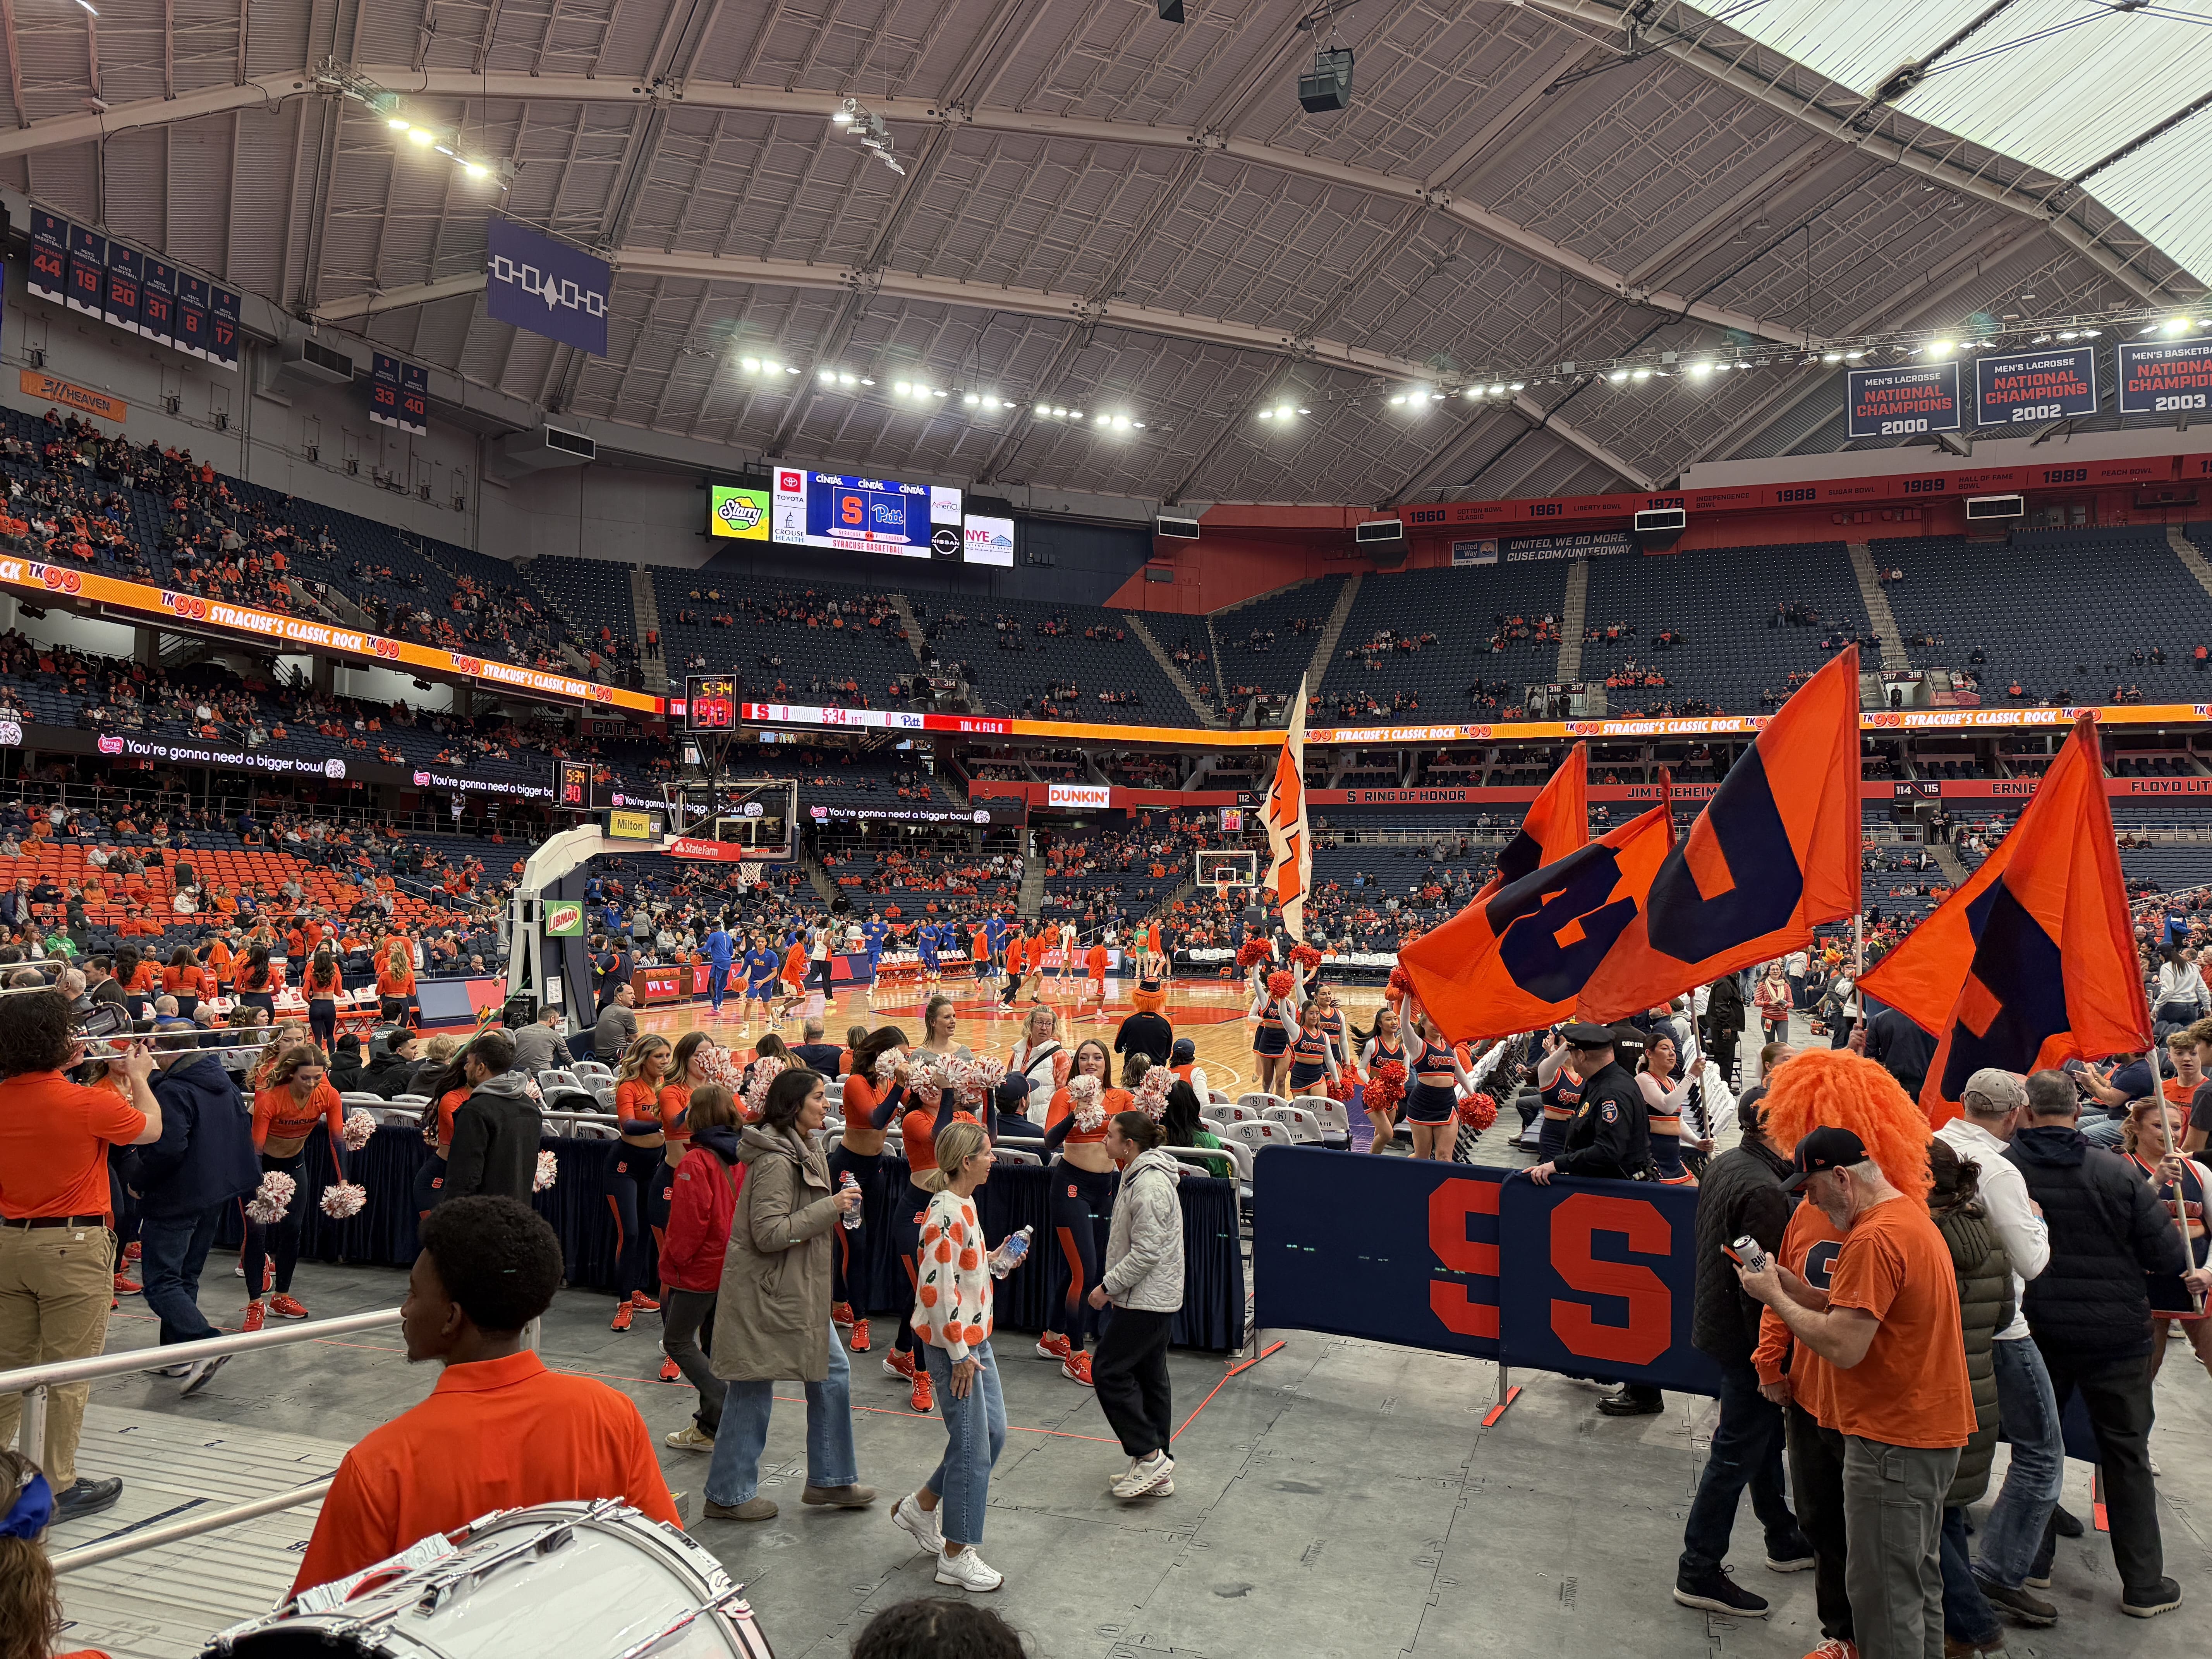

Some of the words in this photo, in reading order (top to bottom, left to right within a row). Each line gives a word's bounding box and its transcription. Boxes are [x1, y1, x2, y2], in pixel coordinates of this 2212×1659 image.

[35, 234, 62, 249] BASKETBALL
[34, 244, 62, 259] COLEMAN
[74, 250, 101, 264] BASKETBALL
[81, 248, 94, 258] MEN'S
[34, 254, 61, 277] 44
[118, 264, 132, 273] MEN'S
[112, 266, 137, 280] BASKETBALL
[76, 270, 96, 291] 19
[147, 281, 171, 294] BASKETBALL
[154, 279, 165, 288] MEN'S
[112, 284, 135, 307] 20
[181, 295, 205, 309] BASKETBALL
[149, 299, 167, 320] 31
[214, 309, 237, 322] BASKETBALL
[186, 314, 197, 332] 8
[216, 327, 233, 345] 17
[2132, 351, 2162, 360] MEN'S
[1995, 364, 2024, 373] MEN'S
[2026, 358, 2075, 370] LACROSSE
[1865, 378, 1893, 386] MEN'S
[1895, 373, 1941, 384] LACROSSE
[1995, 370, 2078, 389] NATIONAL
[67, 388, 110, 411] HEAVEN
[375, 387, 394, 405] 33
[1865, 385, 1944, 402] NATIONAL
[1986, 383, 2087, 404] CHAMPIONS
[404, 398, 424, 415] 40
[1857, 397, 1952, 417] CHAMPIONS
[2156, 394, 2206, 411] 2003
[2012, 404, 2061, 422] 2002
[1881, 419, 1927, 435] 2000
[2043, 469, 2088, 483] 1989
[1903, 479, 1945, 492] 1989
[1647, 498, 1685, 510] 1979
[1696, 493, 1750, 501] INDEPENDENCE
[1776, 488, 1816, 502] 1988
[719, 498, 763, 526] Starry
[842, 496, 862, 524] S
[932, 501, 960, 511] AmeriCU
[1529, 504, 1563, 516] 1961
[872, 504, 904, 525] Pitt
[1410, 510, 1446, 523] 1960
[965, 529, 989, 542] NYE
[1511, 541, 1551, 550] UNITED,
[1556, 538, 1571, 546] WE
[1593, 533, 1627, 543] MORE.
[833, 540, 864, 550] SYRACUSE
[867, 543, 903, 554] BASKETBALL
[1464, 550, 1477, 558] Way
[1507, 544, 1632, 562] CUSE.COM/UNITEDWAY
[210, 606, 284, 634] SYRACUSE'S
[287, 623, 330, 643] CLASSIC
[332, 632, 362, 651] ROCK
[483, 664, 532, 686] SYRACUSE'S
[534, 675, 564, 691] CLASSIC
[565, 681, 586, 696] ROCK
[702, 682, 732, 697] 5:34
[757, 704, 769, 720] S
[783, 706, 788, 720] 0
[823, 709, 846, 723] 5:34
[886, 713, 891, 725] 0
[901, 715, 921, 727] Pitt
[960, 721, 973, 731] TOL
[975, 722, 980, 732] 4
[983, 723, 996, 732] FLS
[998, 724, 1003, 733] 0
[1905, 713, 1972, 725] SYRACUSE'S
[1976, 712, 2021, 724] CLASSIC
[2023, 711, 2056, 723] ROCK
[1603, 721, 1664, 733] SYRACUSE'S
[1668, 720, 1709, 732] CLASSIC
[1711, 719, 1740, 730] ROCK
[1335, 730, 1389, 740] SYRACUSE'S
[1391, 729, 1427, 740] CLASSIC
[1429, 728, 1455, 738] ROCK
[126, 740, 167, 756] You're
[170, 747, 209, 761] gonna
[213, 752, 243, 764] need
[246, 757, 254, 765] a
[256, 755, 294, 771] bigger
[296, 761, 323, 773] bowl
[566, 769, 585, 783] 5:34
[432, 775, 459, 786] You're
[460, 780, 486, 790] gonna
[488, 783, 508, 792] need
[517, 784, 543, 797] bigger
[565, 784, 581, 802] 30
[1627, 788, 1651, 797] JIM
[1896, 786, 1911, 795] 114
[1923, 784, 1939, 793] 115
[1992, 783, 2037, 794] ERNIE
[2131, 781, 2181, 792] FLOYD
[1051, 789, 1108, 804] DUNKIN'
[1365, 791, 1395, 802] RING
[1399, 791, 1415, 800] OF
[1420, 790, 1466, 801] HONOR
[829, 807, 856, 818] You're
[858, 811, 886, 820] gonna
[888, 809, 910, 819] need
[920, 810, 949, 822] bigger
[950, 812, 972, 821] bowl
[617, 819, 643, 831] Milton
[650, 822, 661, 833] CAT
[548, 909, 578, 931] LIBMAN
[753, 958, 765, 966] Pitt
[1325, 1102, 1332, 1111] S
[1234, 1110, 1242, 1120] S
[1295, 1113, 1302, 1122] S
[1261, 1126, 1272, 1137] S
[618, 1161, 627, 1173] S
[1551, 1192, 1671, 1365] S
